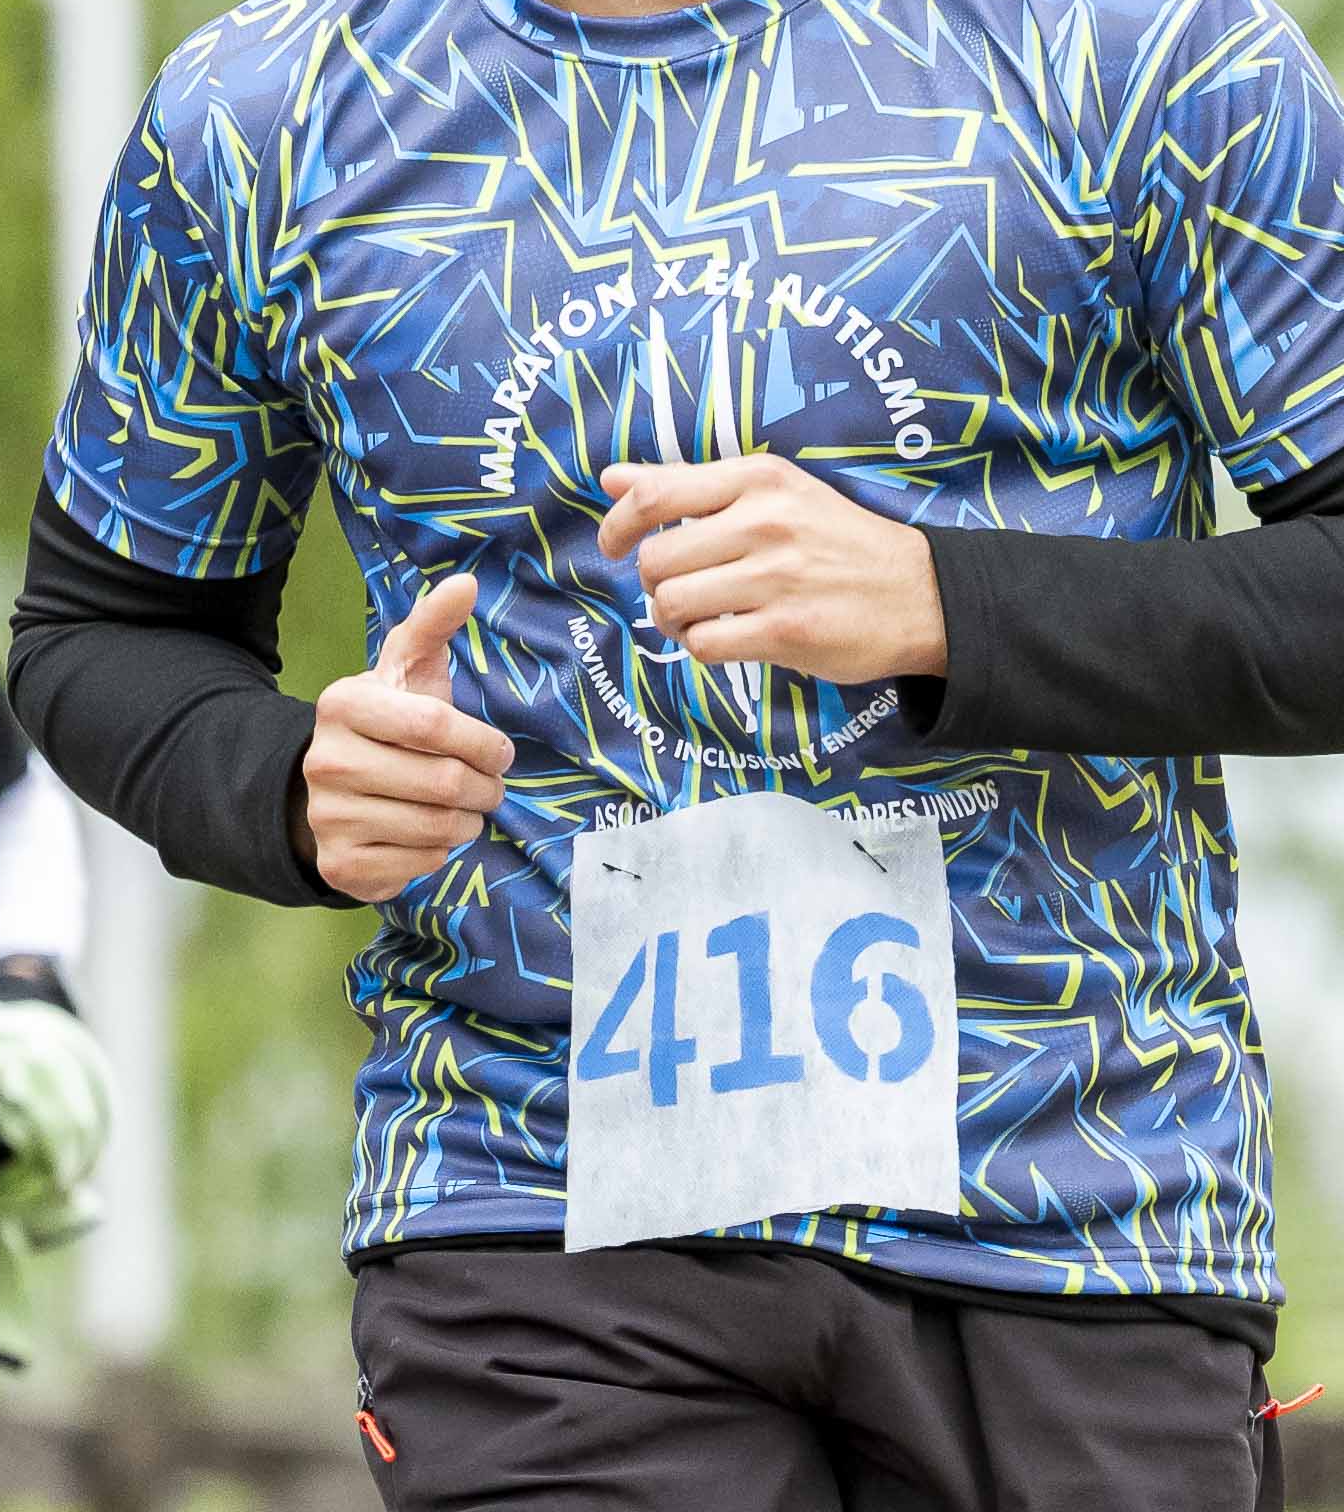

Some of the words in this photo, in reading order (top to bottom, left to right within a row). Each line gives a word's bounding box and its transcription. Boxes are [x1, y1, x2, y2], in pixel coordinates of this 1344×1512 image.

[479, 272, 639, 495] MARATÓN
[652, 263, 689, 298] X
[703, 259, 755, 300] EL
[765, 273, 934, 461] AUTISMO
[567, 616, 665, 754] MOVIMIENTO,
[799, 743, 818, 764] Y
[921, 779, 999, 825] UNIDOS
[577, 910, 935, 1108] 416
